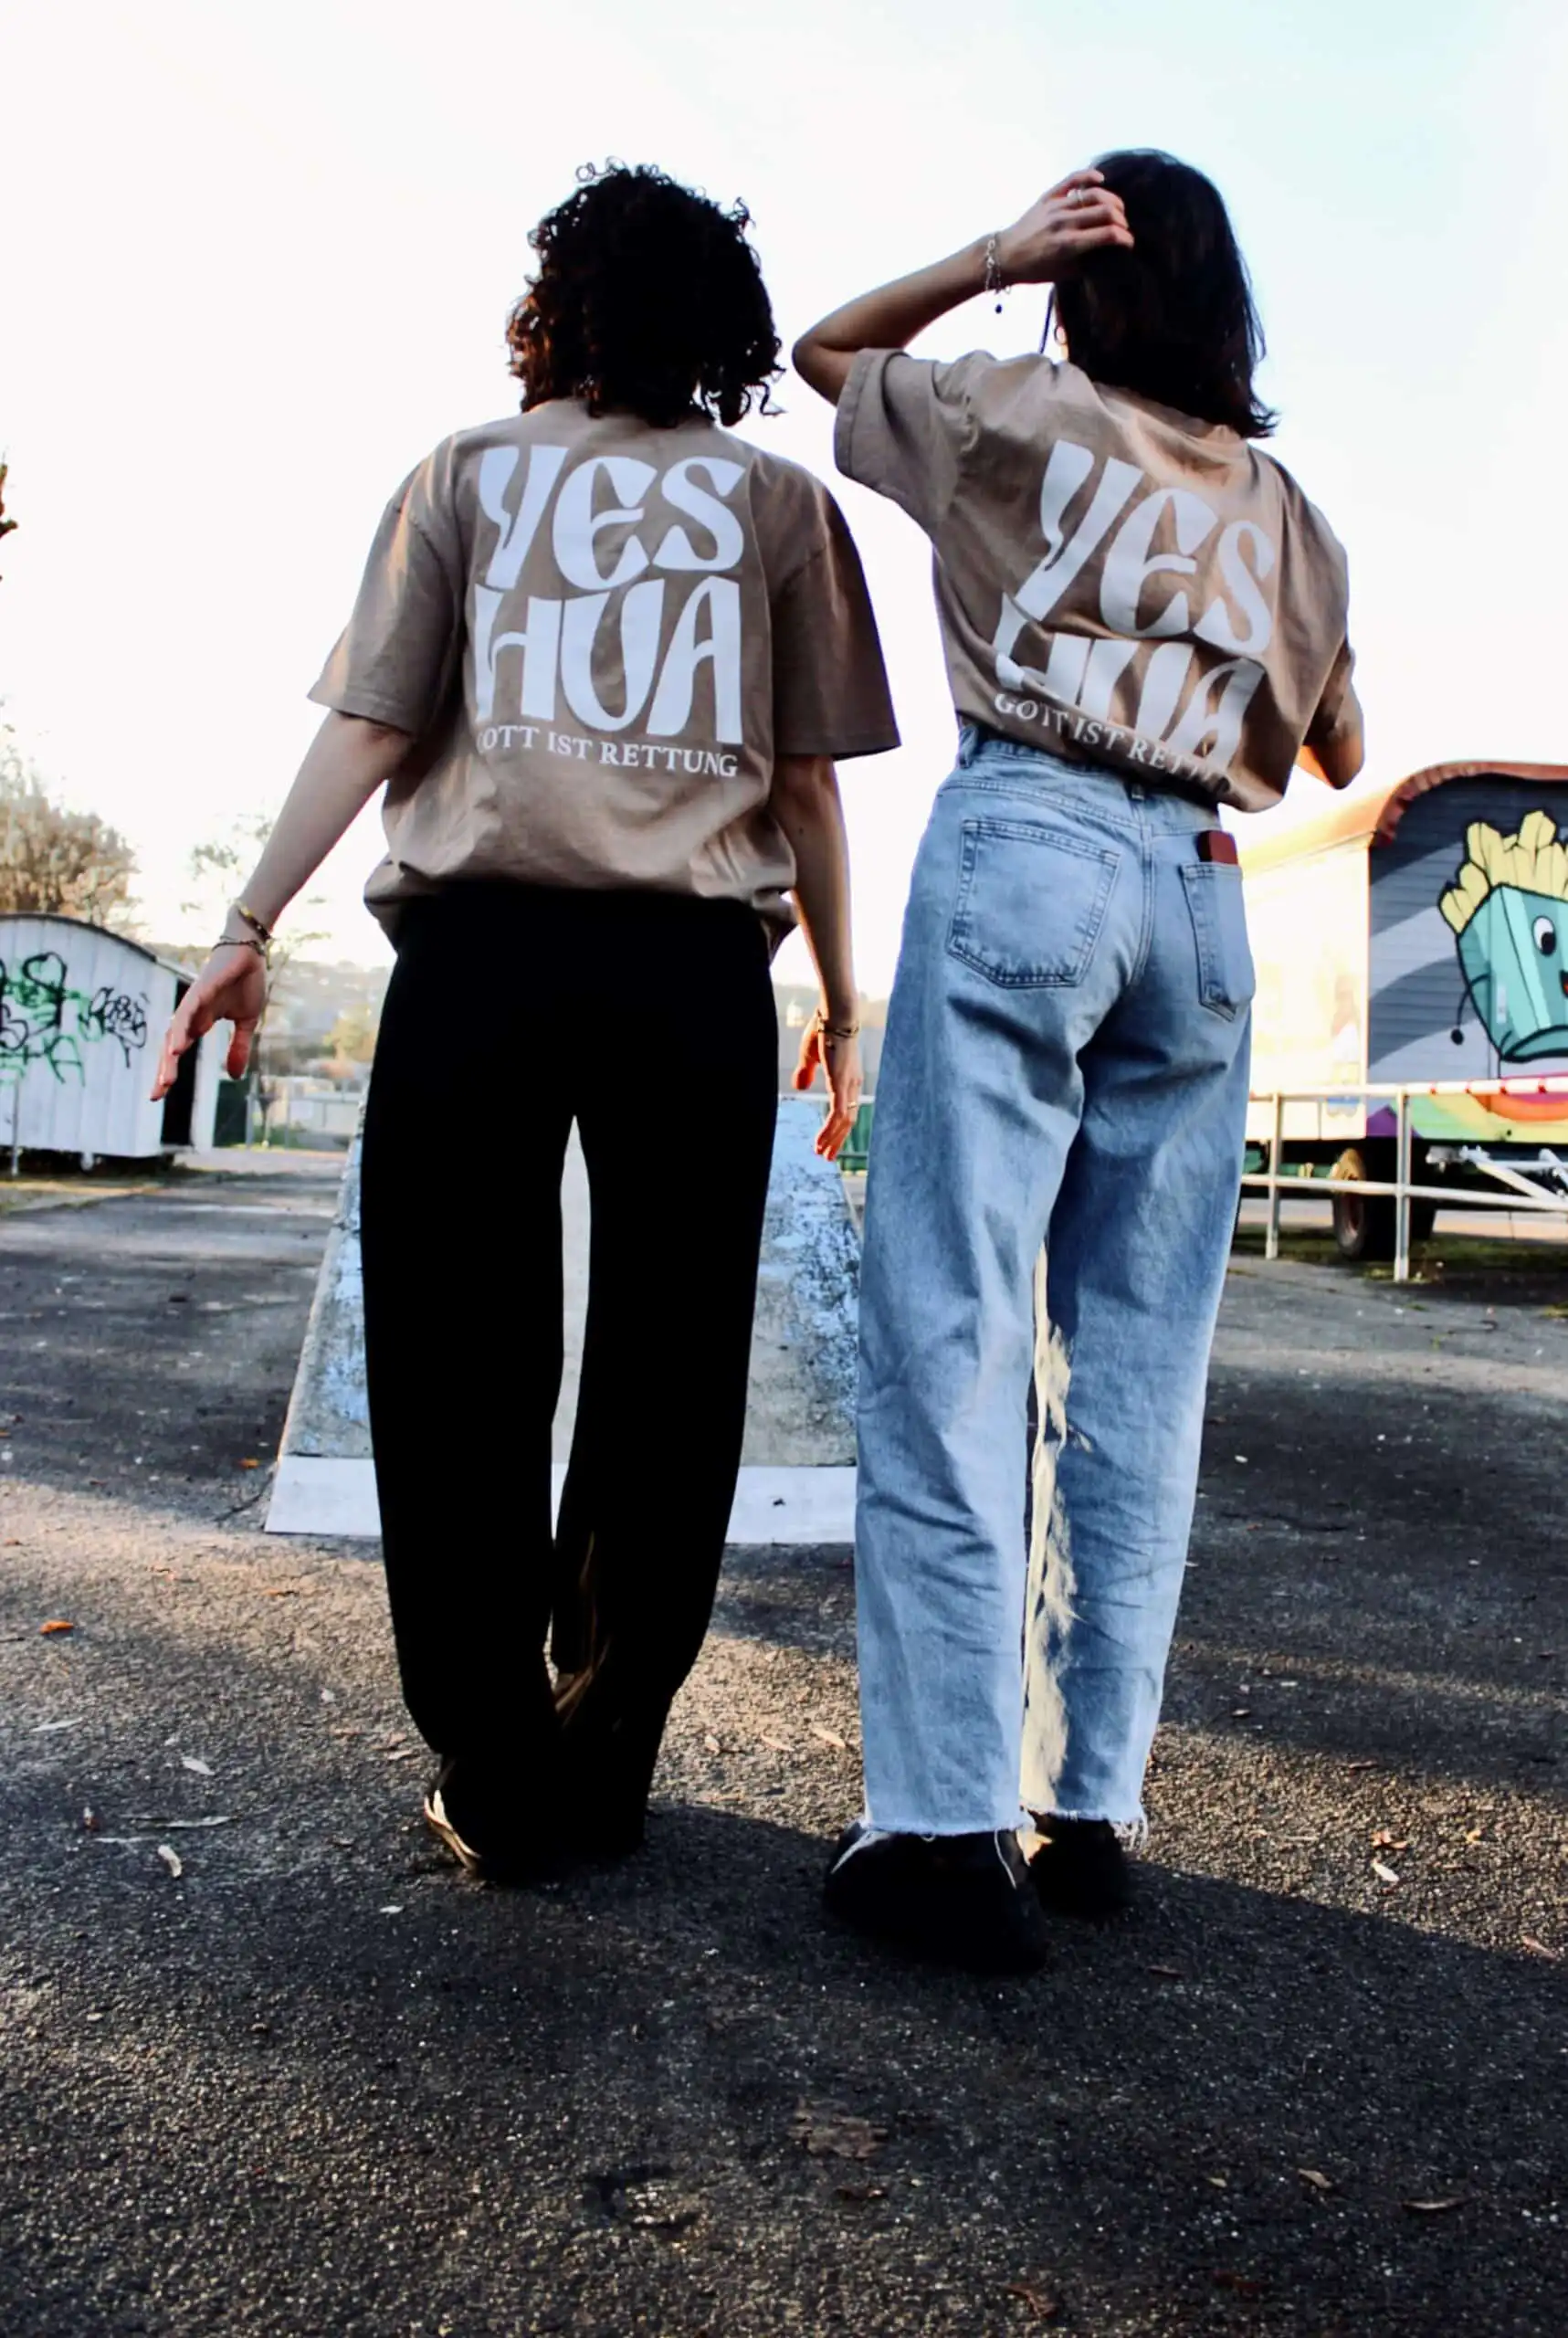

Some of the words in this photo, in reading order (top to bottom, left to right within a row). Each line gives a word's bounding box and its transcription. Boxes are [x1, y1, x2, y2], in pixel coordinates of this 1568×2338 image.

[475, 576, 742, 744] HUA
[547, 732, 593, 760] IST
[599, 741, 738, 776] RETTUNG
[1074, 717, 1124, 750] IST
